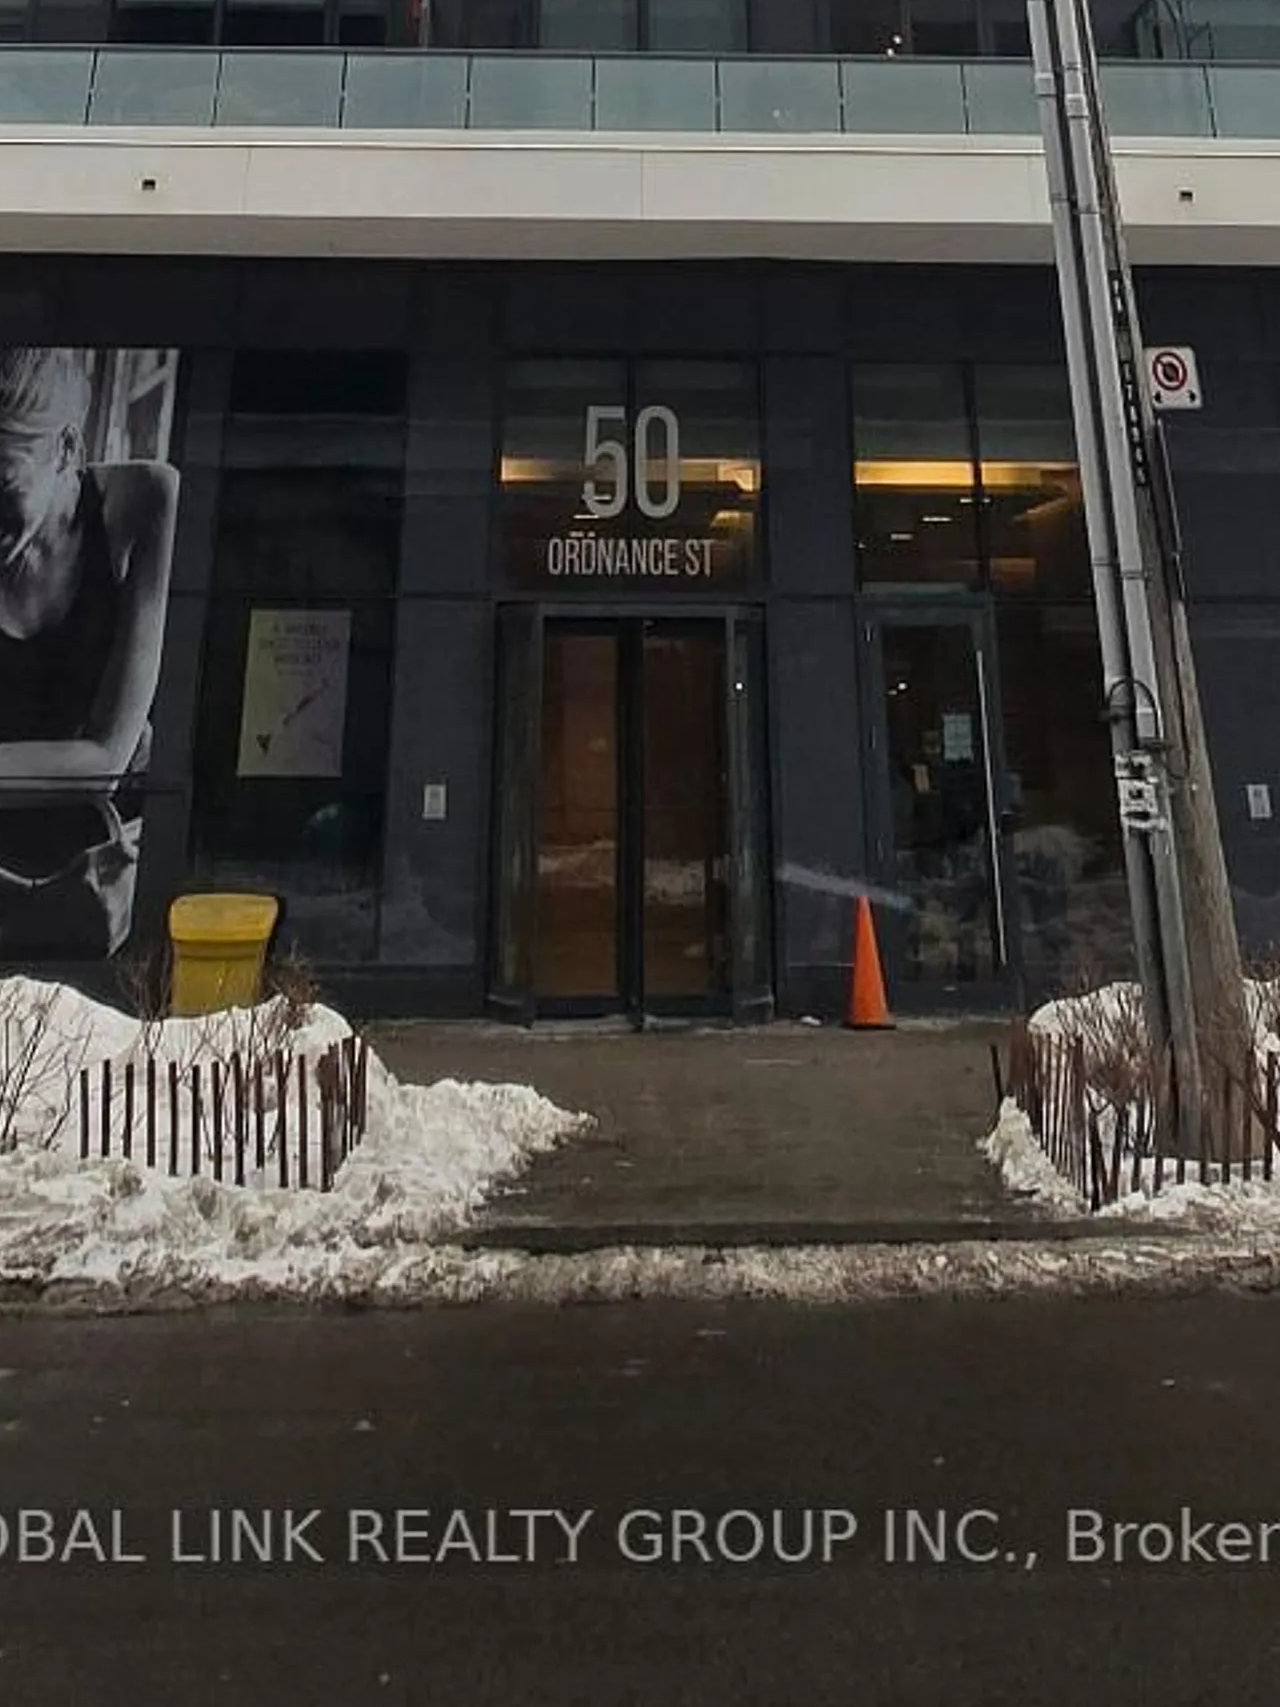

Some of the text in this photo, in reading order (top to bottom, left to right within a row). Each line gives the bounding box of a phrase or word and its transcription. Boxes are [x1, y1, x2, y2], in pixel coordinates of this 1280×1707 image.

[582, 405, 679, 519] 50
[547, 537, 715, 577] ORDNANCE ST
